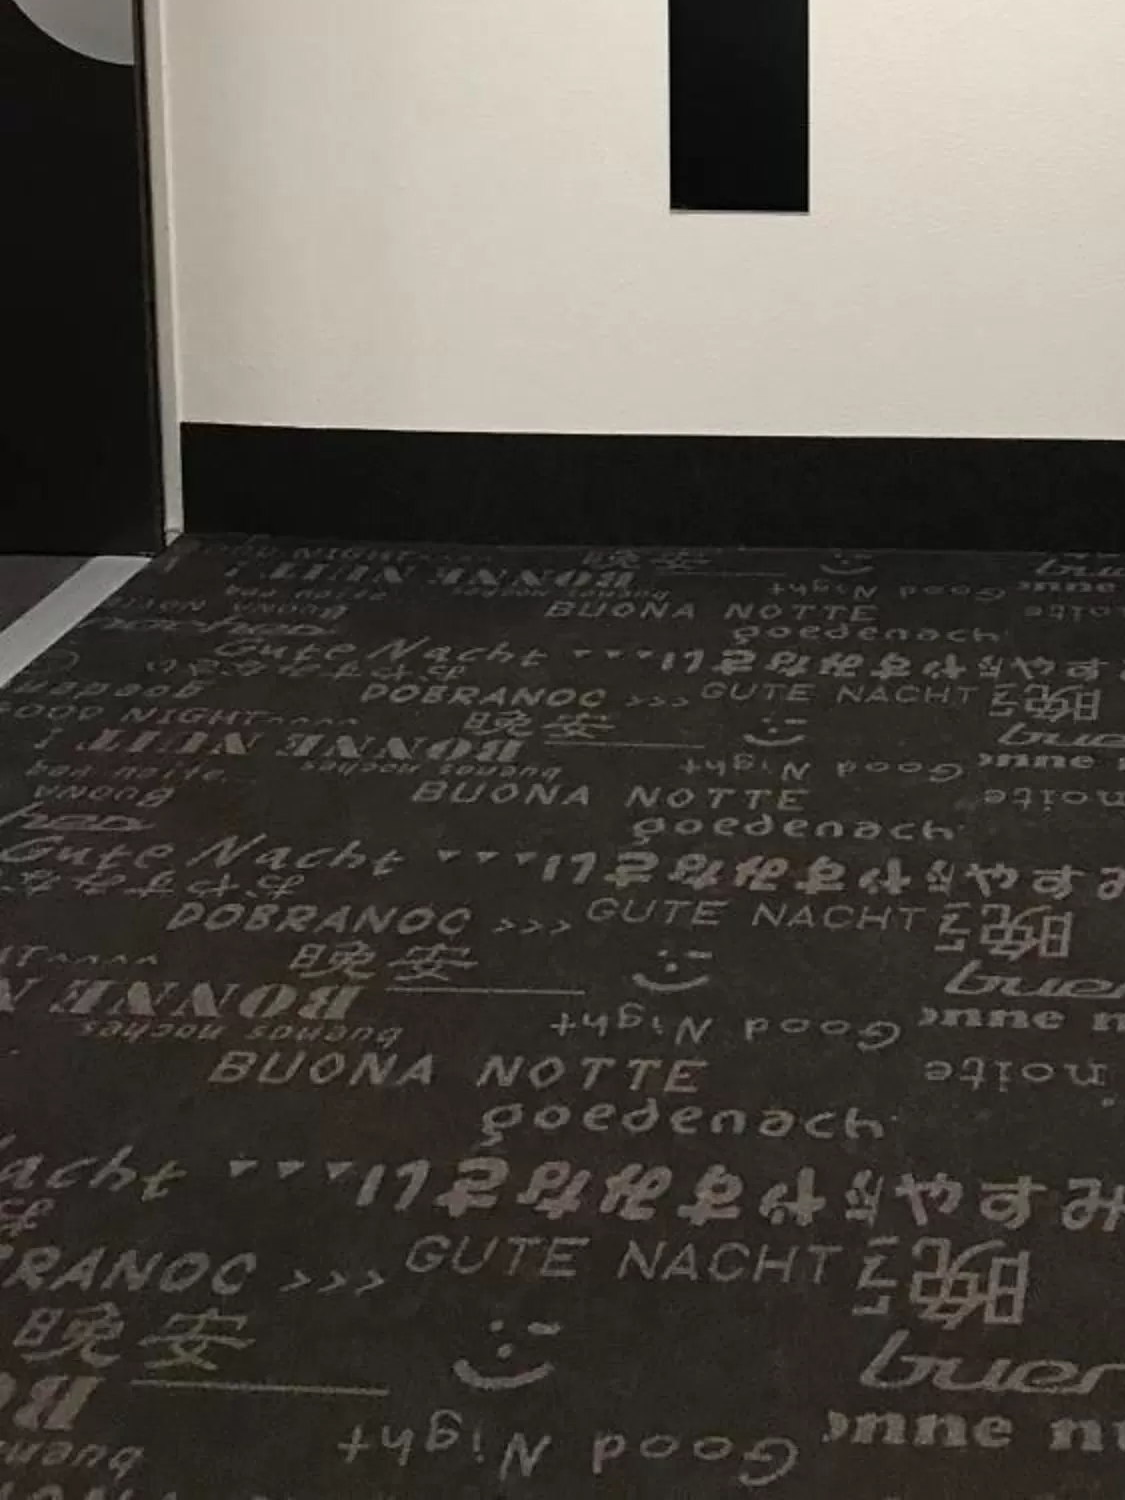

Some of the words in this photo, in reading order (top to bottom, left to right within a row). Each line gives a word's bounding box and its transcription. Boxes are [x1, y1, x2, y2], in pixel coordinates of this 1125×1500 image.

[360, 683, 606, 705] DOBRANOC
[700, 683, 815, 701] GUTE
[835, 684, 980, 703] NACHT
[414, 782, 590, 806] BUONA
[625, 784, 810, 811] NOTTE
[165, 902, 473, 934] DOBRANOC
[585, 898, 730, 926] GUTE
[752, 902, 927, 931] NACHT
[550, 1003, 714, 1046] Night
[744, 1016, 900, 1051] Good
[208, 1051, 433, 1086] BUONA
[476, 1054, 708, 1093] NOTTE
[404, 1235, 591, 1279] GUTE
[616, 1239, 843, 1285] NACHT
[337, 1408, 551, 1483] Night
[590, 1434, 800, 1488] Good
